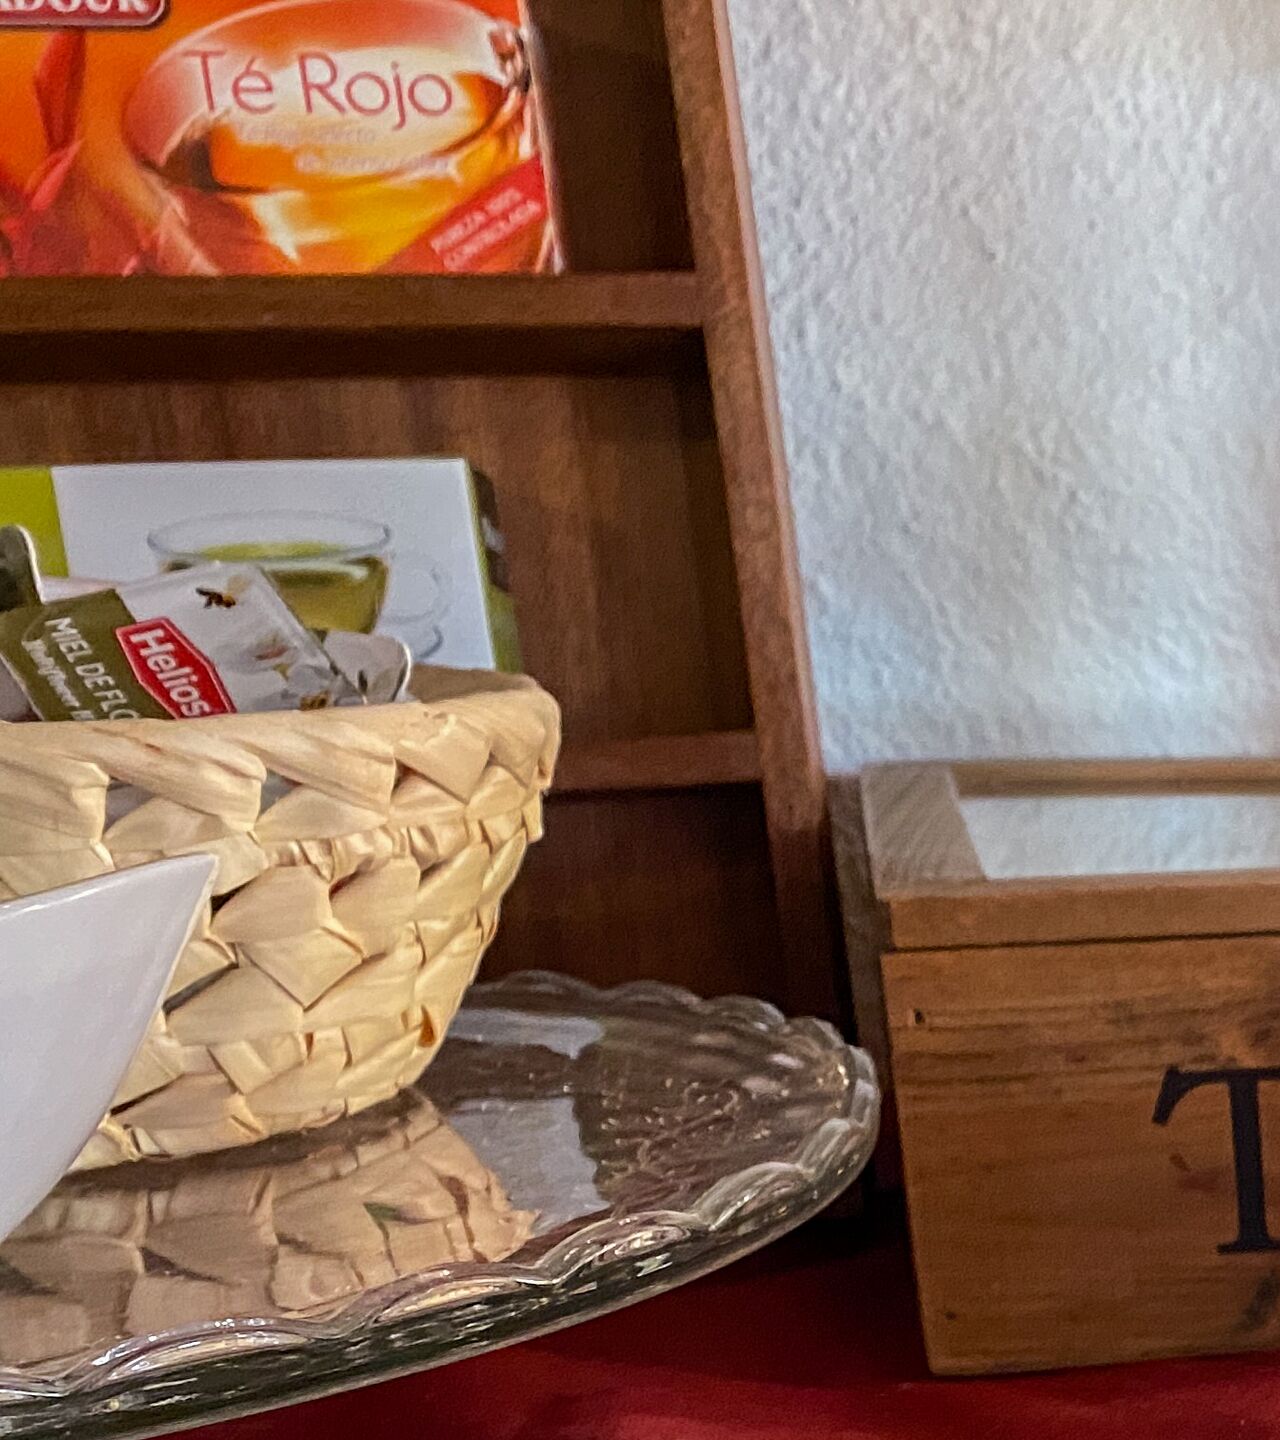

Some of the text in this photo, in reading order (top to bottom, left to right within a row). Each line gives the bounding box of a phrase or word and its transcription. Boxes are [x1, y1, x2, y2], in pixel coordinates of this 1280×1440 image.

[185, 50, 453, 129] Té Rojo
[44, 617, 93, 663] MIEL
[75, 662, 116, 690] DE
[129, 628, 210, 717] Helios
